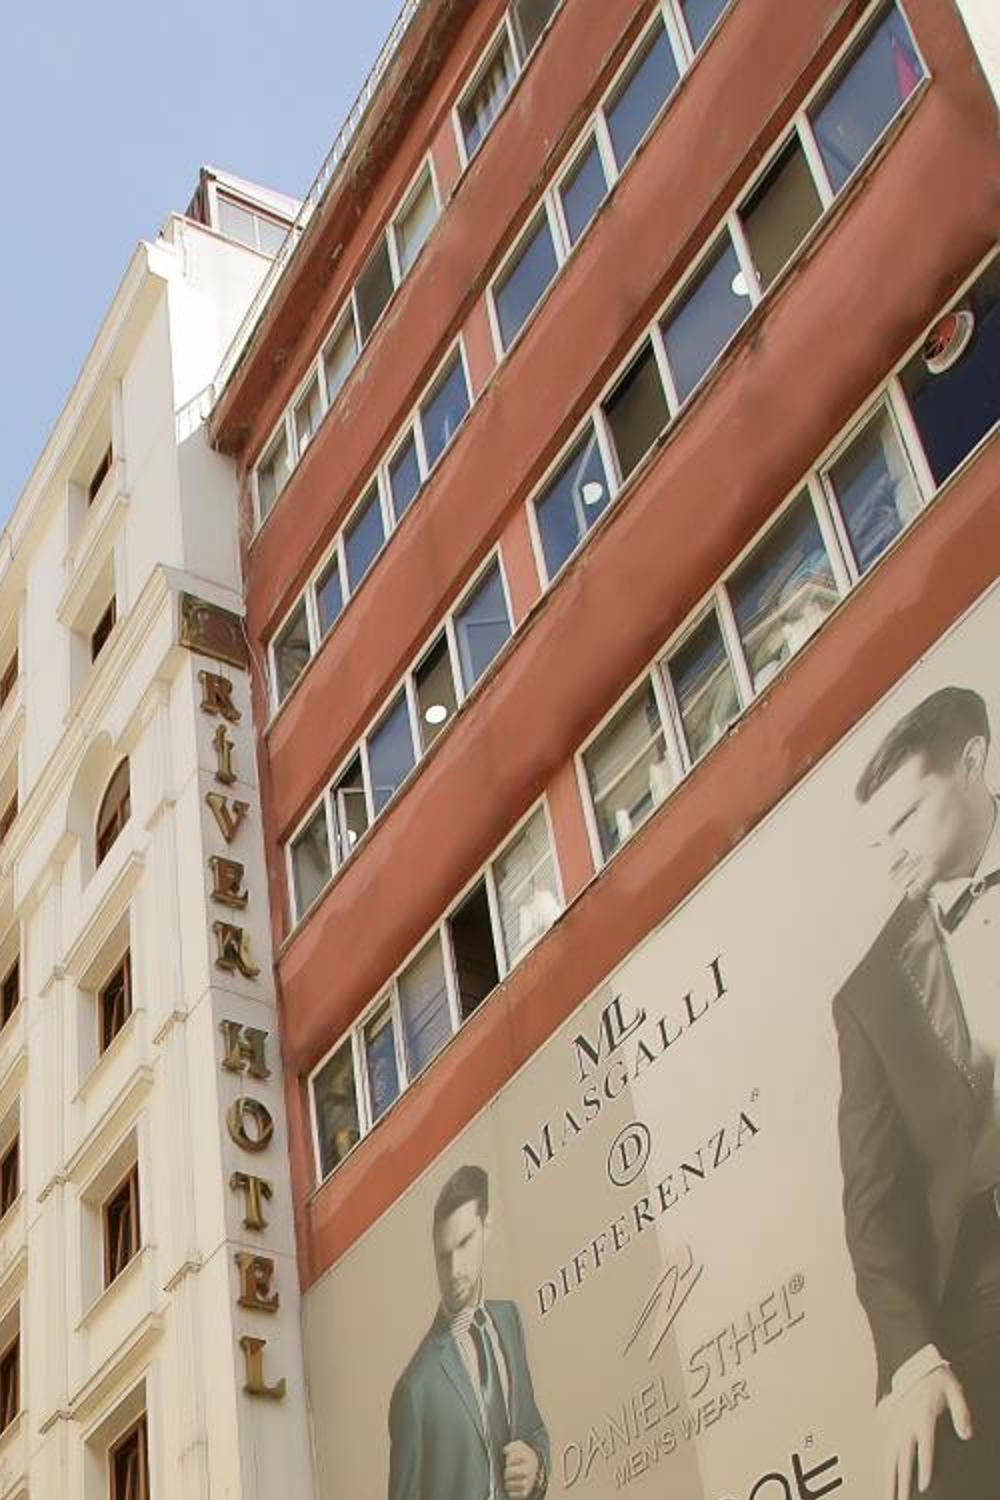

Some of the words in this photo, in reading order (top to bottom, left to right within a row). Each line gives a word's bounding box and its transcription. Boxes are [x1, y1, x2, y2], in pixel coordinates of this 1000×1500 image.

[520, 953, 730, 1182] MASGALLI
[221, 1019, 286, 1402] HOTEL
[537, 1111, 761, 1315] DIFFERENZA
[561, 1374, 679, 1490] DANIEL
[615, 1429, 678, 1491] MEN'S
[684, 1379, 750, 1440] WEAR
